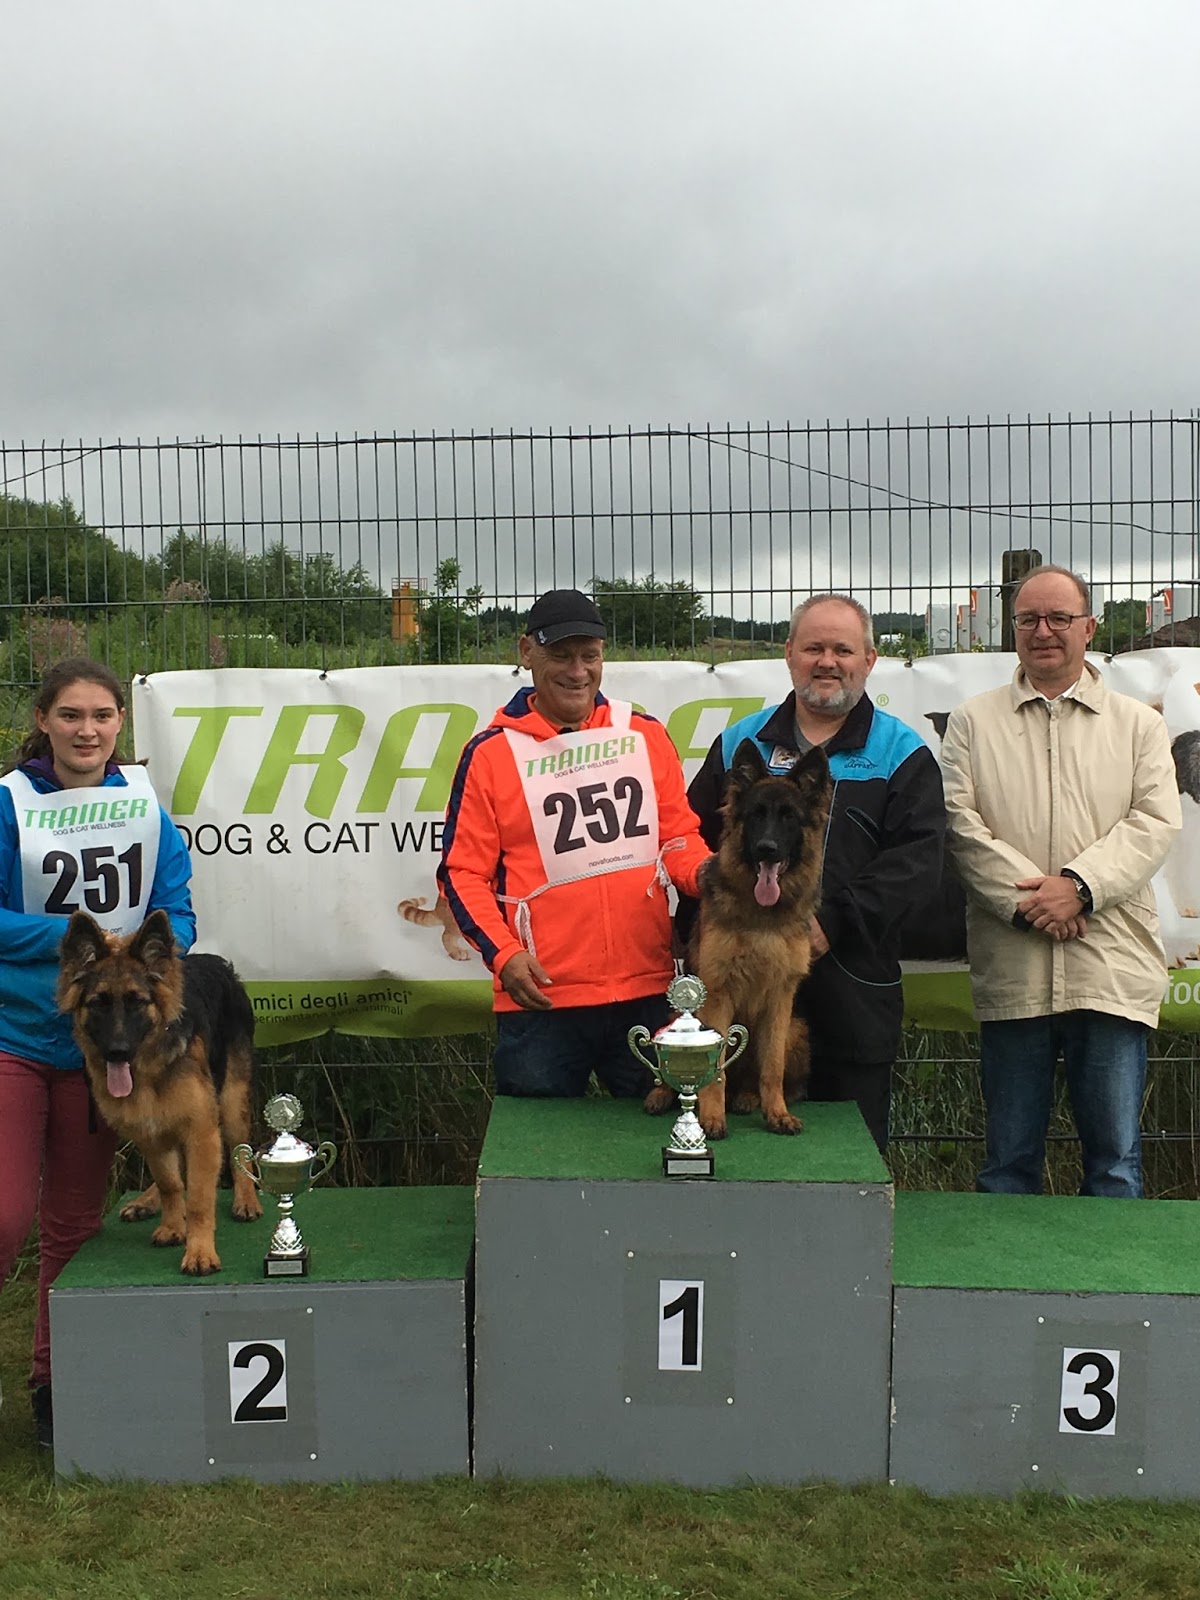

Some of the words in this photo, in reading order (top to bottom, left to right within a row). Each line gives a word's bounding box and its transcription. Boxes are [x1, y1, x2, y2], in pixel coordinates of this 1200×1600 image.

[524, 735, 636, 778] TRAINER
[574, 764, 586, 772] CAT
[587, 758, 619, 769] WELLNESS
[23, 799, 149, 829] TRAINER
[75, 824, 88, 832] CAT
[90, 821, 126, 831] WELLNESS
[543, 776, 650, 855] 252
[266, 823, 291, 855] &
[304, 822, 380, 855] CAT
[42, 842, 142, 914] 251
[588, 854, 634, 867] novafoods.com
[253, 994, 293, 1010] mici
[301, 992, 348, 1010] degli
[663, 1287, 699, 1366] 1
[233, 1343, 287, 1422] 2
[1063, 1352, 1116, 1432] 3
